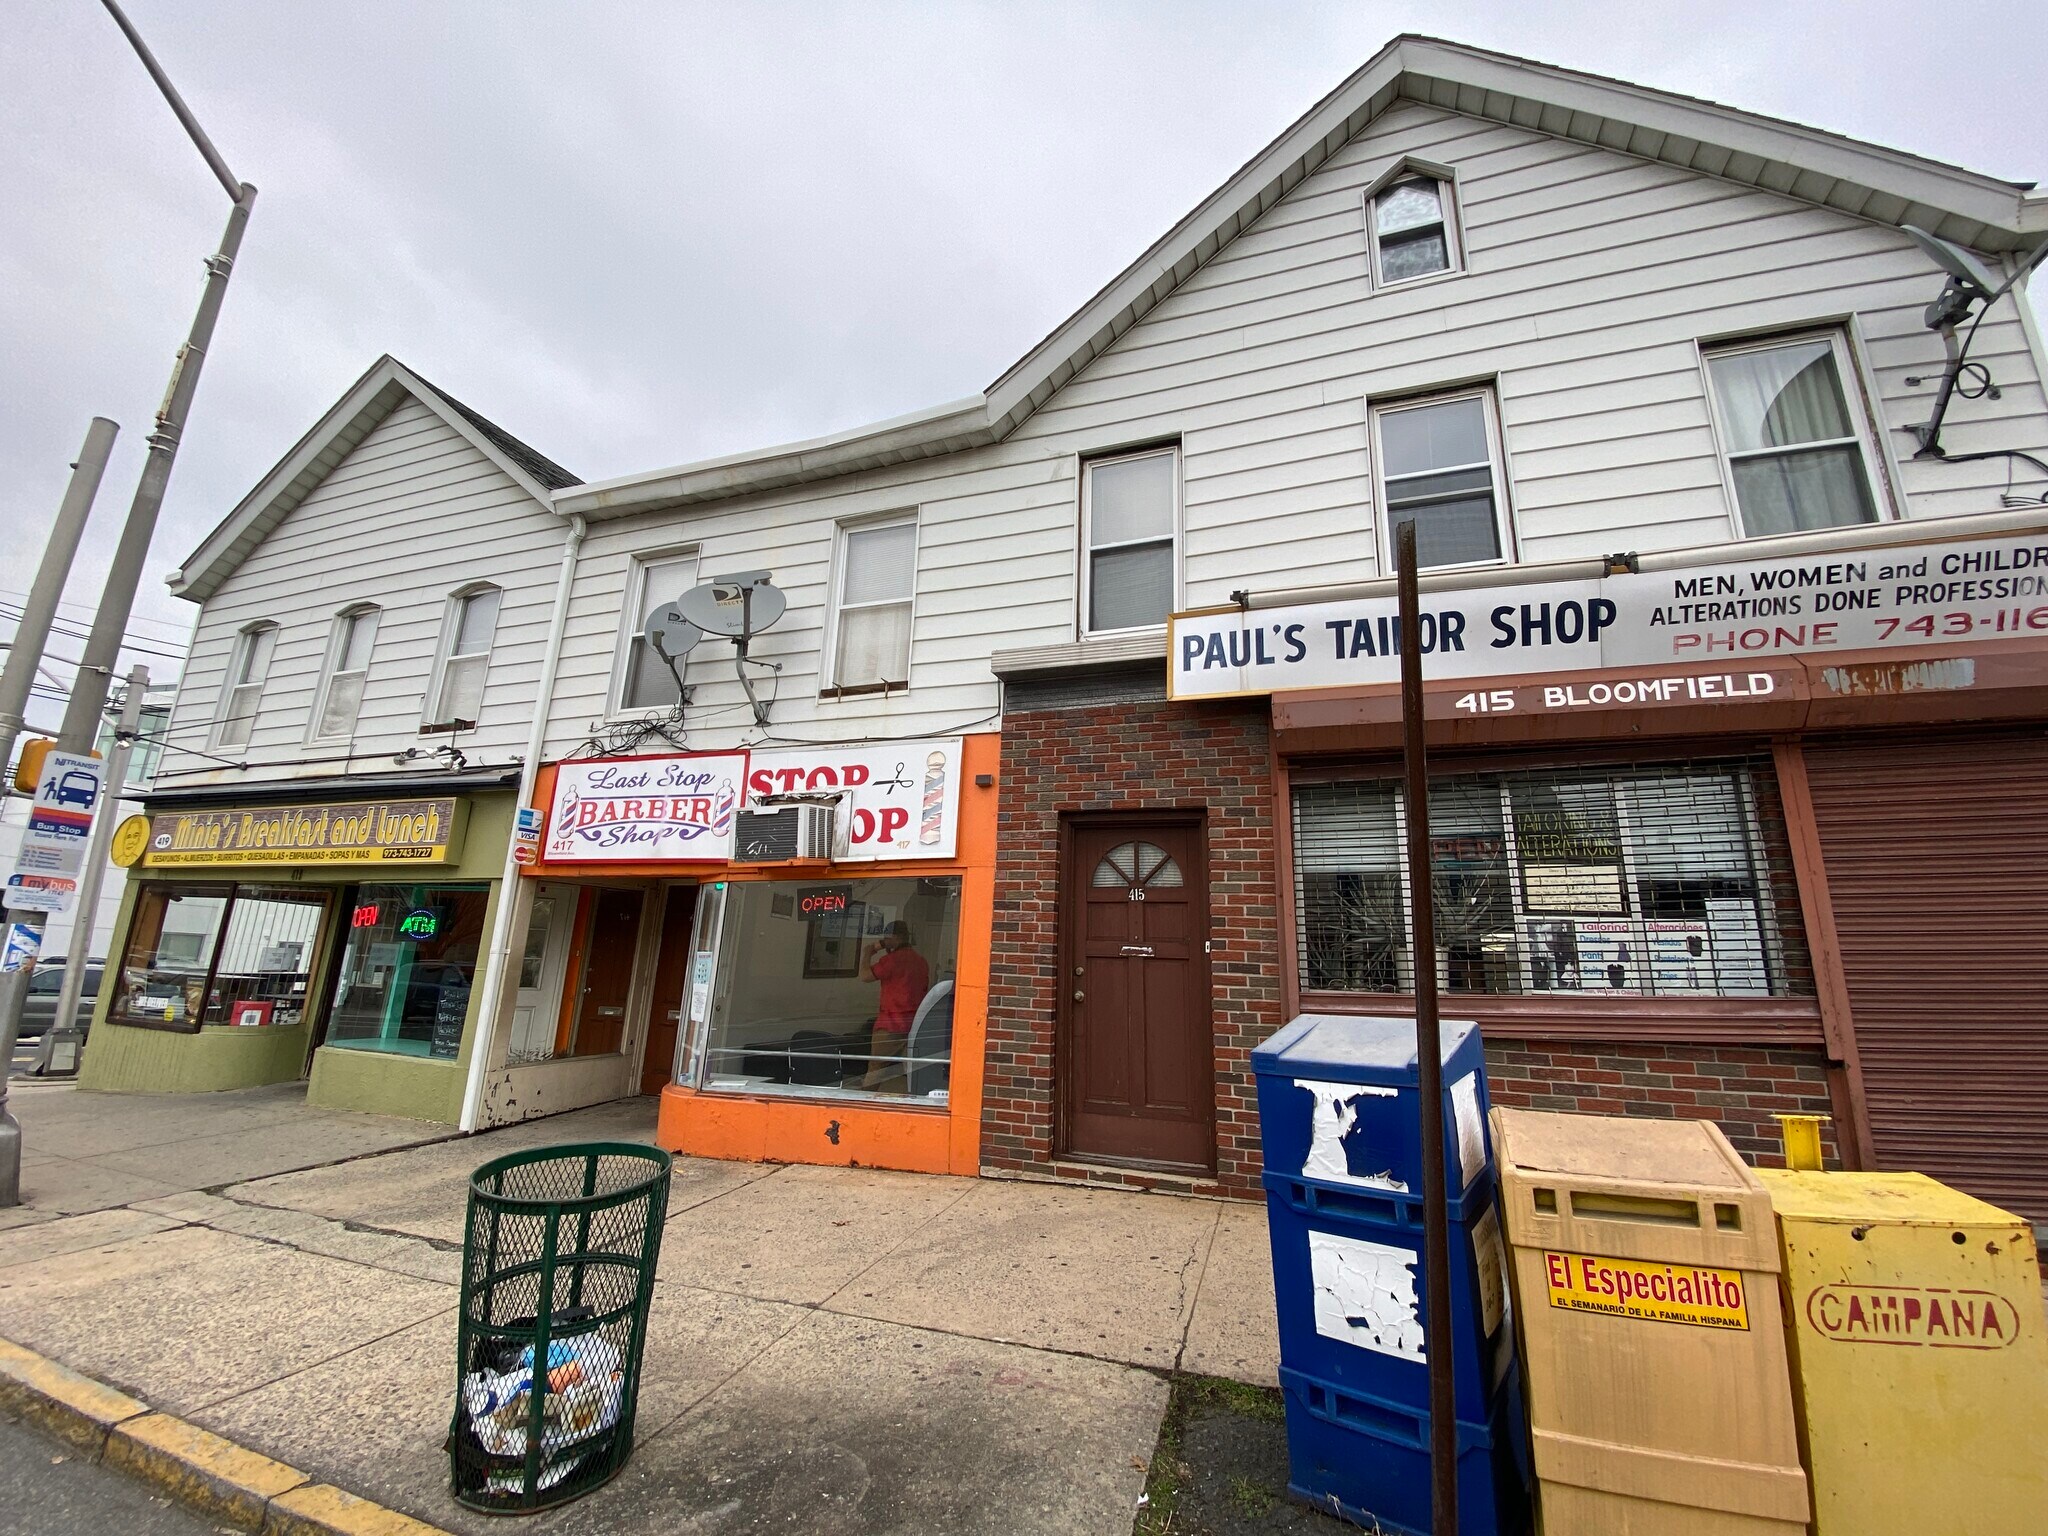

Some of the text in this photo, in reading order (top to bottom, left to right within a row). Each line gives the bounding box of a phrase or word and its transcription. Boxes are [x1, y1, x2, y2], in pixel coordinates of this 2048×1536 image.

[1674, 546, 2048, 599] MEN, WOMEN and CHILDR
[1649, 576, 2048, 626] ALTERATIONS DONE PROFESSION
[1182, 623, 1307, 672] PAUL'S
[1490, 598, 1618, 649] SHOP
[1673, 622, 1839, 655] PHONE
[1455, 673, 1775, 713] 415 BLOOMFIELD
[588, 764, 716, 793] Last Stop
[576, 798, 711, 827] BARBER
[36, 822, 81, 835] Bus Stop
[236, 809, 329, 848] Breakfast
[330, 807, 375, 845] and
[520, 832, 535, 840] VISA
[598, 824, 680, 847] Shop
[157, 837, 170, 846] 419
[383, 848, 431, 858] 973-743-1727
[552, 840, 575, 851] 417
[897, 841, 911, 849] 417
[1516, 833, 1617, 857] ALTERATIONS
[152, 855, 181, 863] DESAYUNOS
[183, 854, 214, 862] ALMUERZOS
[216, 853, 244, 861] BURRITOS
[247, 852, 285, 860] QUESADILLAS
[288, 851, 325, 860] EMPANADAS
[329, 850, 349, 859] SOPAS
[802, 895, 846, 912] OPEN
[1128, 888, 1145, 901] 415
[353, 906, 378, 927] OPEN
[400, 916, 436, 933] ATM
[1548, 1254, 1573, 1289] El
[1582, 1258, 1741, 1309] Especialito
[1557, 1298, 1742, 1327] EL SEMANARIO DE LA FAMILIA HISPANA
[1820, 1293, 2004, 1339] CAMPANA
